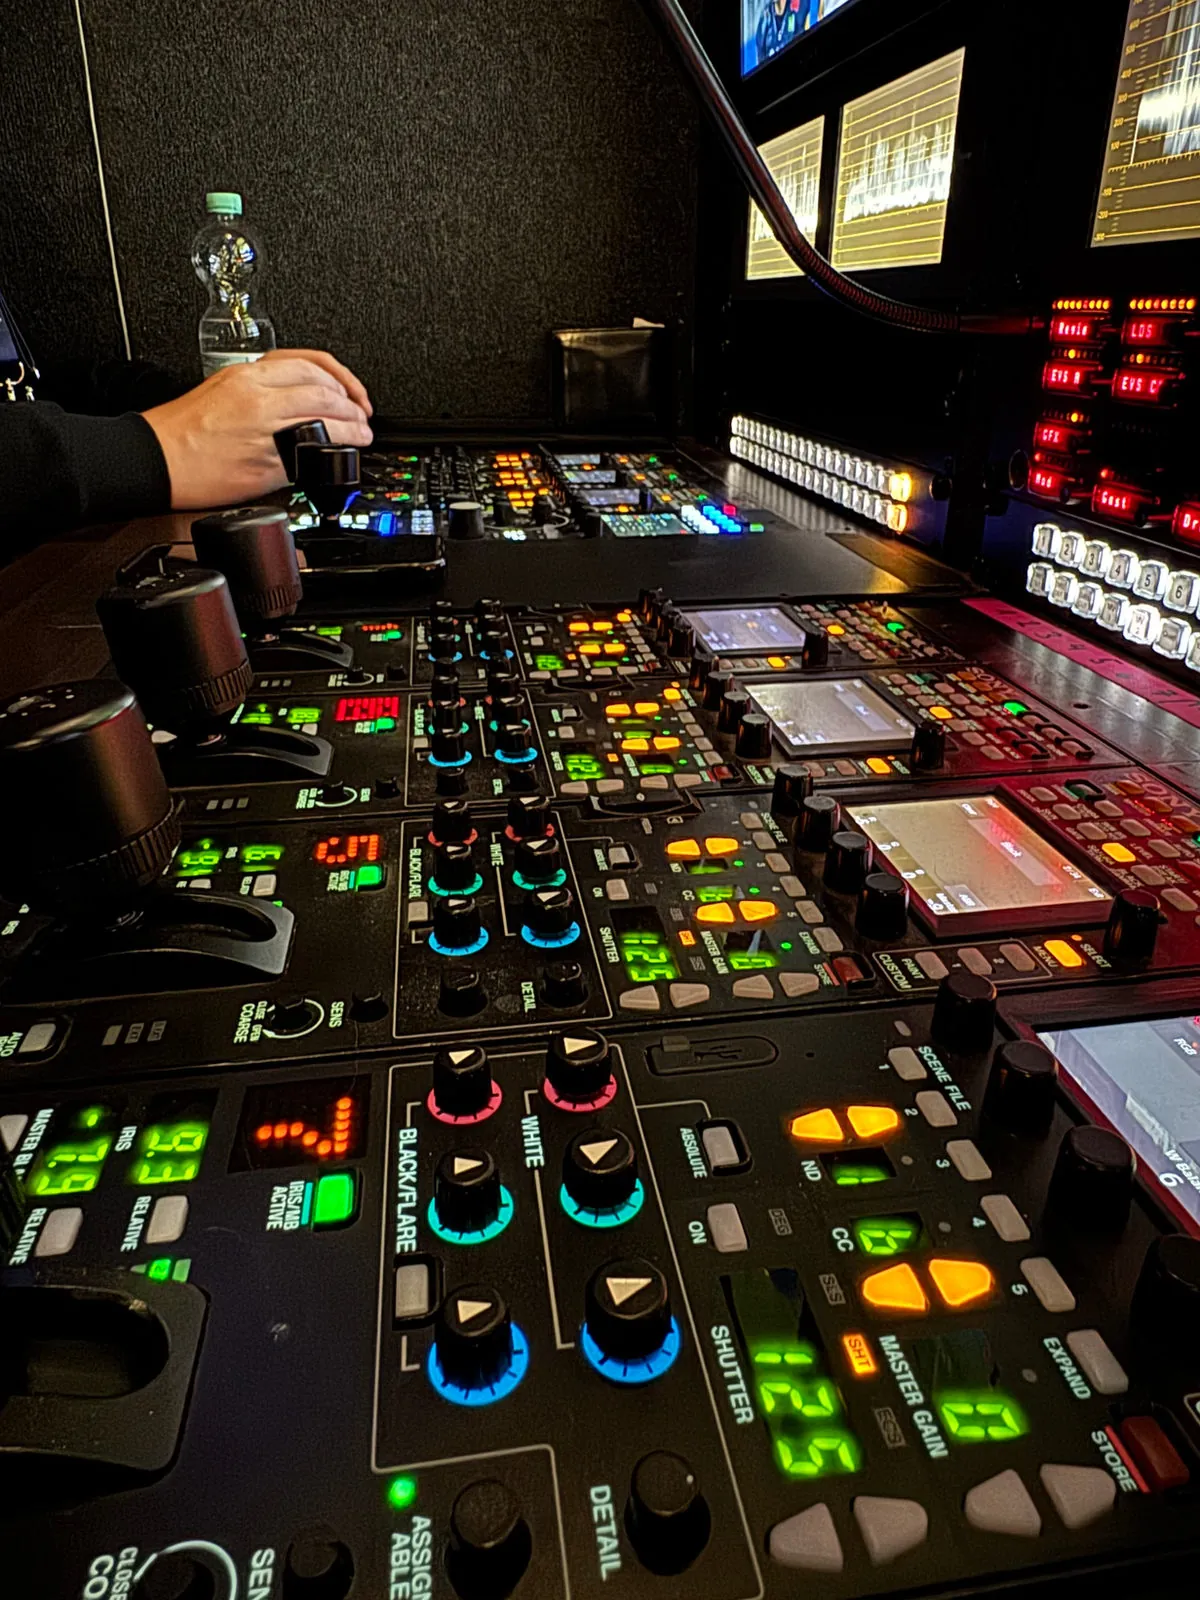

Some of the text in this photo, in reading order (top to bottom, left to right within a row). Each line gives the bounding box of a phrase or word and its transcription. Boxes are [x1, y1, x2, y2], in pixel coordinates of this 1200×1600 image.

[1051, 368, 1068, 383] EVS
[1121, 376, 1142, 392] EVS
[1042, 428, 1060, 443] GFX
[1183, 512, 1200, 531] Dr
[1064, 543, 1071, 556] 2
[1088, 553, 1095, 566] 3
[1114, 564, 1122, 577] 4
[1143, 574, 1151, 588] 5
[1174, 585, 1184, 599] 6
[316, 834, 379, 865] 5
[599, 926, 621, 964] SHUTTER
[623, 937, 674, 982] 125
[1033, 946, 1059, 968] MENU
[1080, 943, 1112, 969] SELECT
[879, 953, 912, 989] CUSTOM
[901, 957, 925, 980] PAINT
[520, 981, 537, 1013] DETAIL
[233, 1003, 256, 1044] COARSE
[328, 1001, 344, 1028] SENS
[1, 1032, 23, 1057] AUTO
[1173, 1037, 1198, 1056] RGB
[918, 1045, 972, 1112] SCENE FILE
[256, 1097, 352, 1156] 7
[904, 1108, 918, 1118] 2
[22, 1108, 54, 1151] MASTER
[115, 1126, 138, 1152] IRIS
[521, 1115, 545, 1169] WHITE
[679, 1127, 707, 1179] ABSOLUTE
[936, 1159, 950, 1168] 3
[801, 1160, 822, 1182] ND
[1159, 1172, 1183, 1188] 6
[284, 1180, 306, 1231] IRIS/MB
[396, 1128, 418, 1253] BLACK/FLARE
[121, 1195, 151, 1253] RELATIVE
[265, 1186, 289, 1232] ACTIVE
[769, 1209, 792, 1236] DEG
[972, 1217, 987, 1228] 4
[9, 1207, 47, 1267] RELATIVE
[688, 1221, 707, 1245] ON
[832, 1227, 854, 1253] CC
[1011, 1283, 1028, 1296] 5
[844, 1335, 874, 1372] SHT
[1042, 1336, 1092, 1400] EXPAND
[711, 1325, 754, 1425] SHUTTER
[754, 1350, 858, 1475] 125
[878, 1334, 949, 1460] MASTER GAIN
[941, 1401, 1023, 1439] 0
[1090, 1429, 1137, 1492] STORE
[590, 1485, 622, 1581] DETAIL
[109, 1547, 138, 1600] CLOSE
[390, 1533, 411, 1600] ABLE
